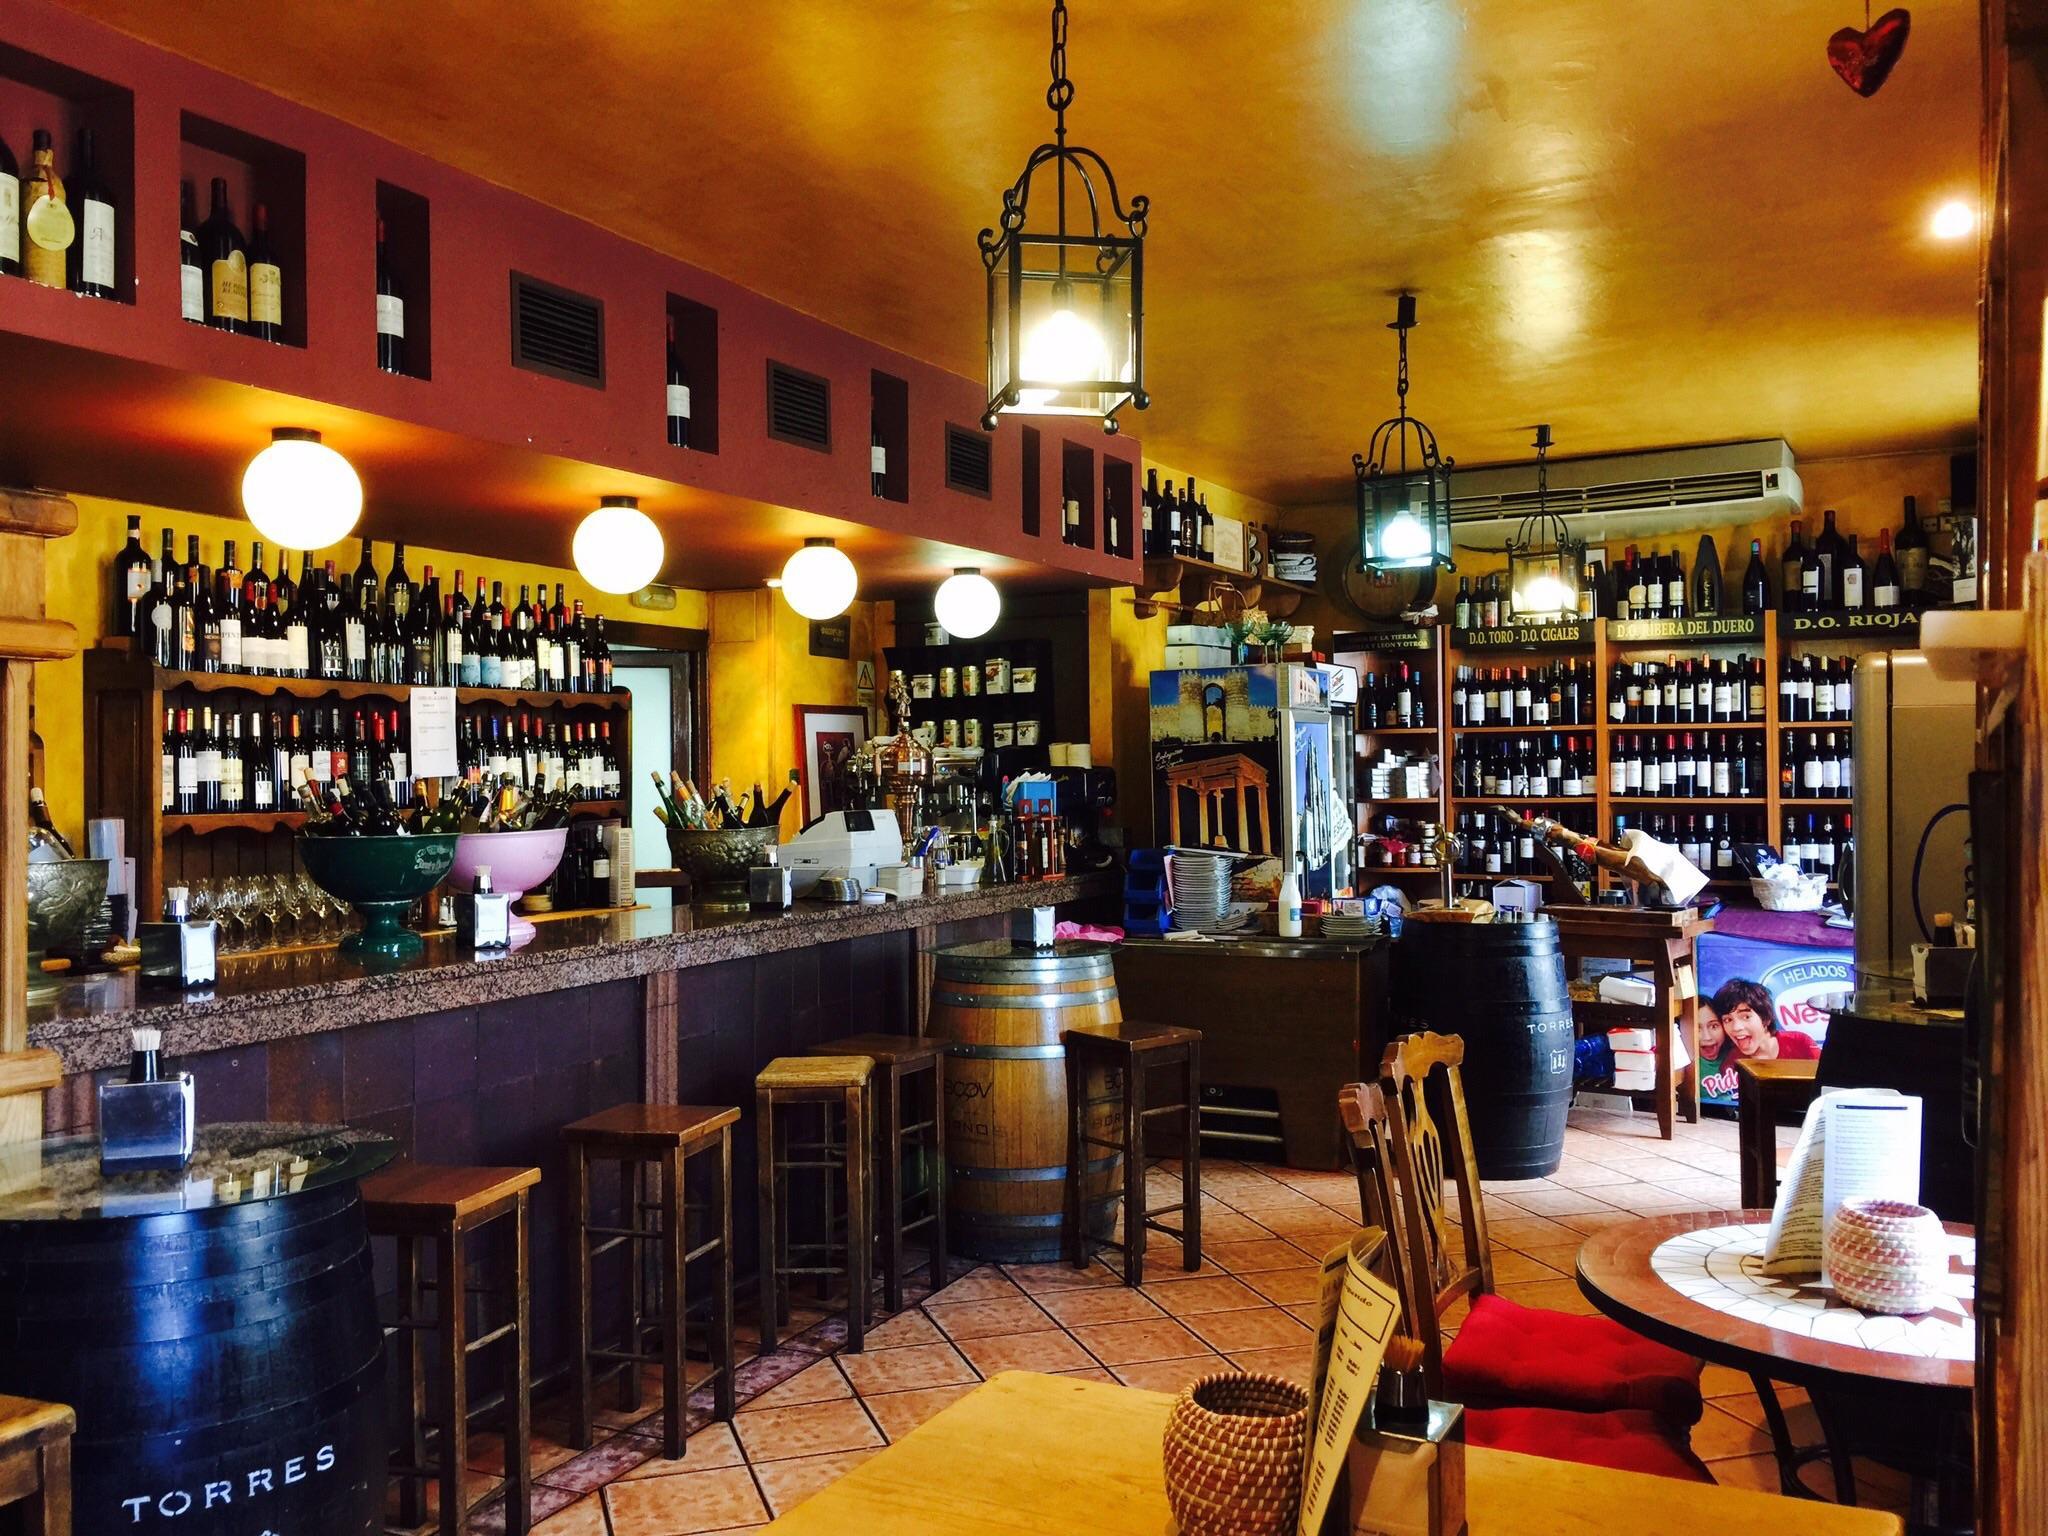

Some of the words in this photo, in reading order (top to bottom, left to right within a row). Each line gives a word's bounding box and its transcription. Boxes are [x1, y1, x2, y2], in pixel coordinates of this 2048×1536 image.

[1646, 622, 1684, 636] RIBERA
[1687, 621, 1710, 635] DEL
[1712, 618, 1754, 634] DUERO
[1793, 616, 1841, 630] D.O.
[1848, 612, 1919, 628] RIOJA
[1469, 631, 1487, 644] D.O.
[1489, 630, 1514, 643] TORO
[1520, 629, 1539, 642] D.O.
[1541, 627, 1580, 641] CIGALES
[1783, 965, 1847, 985] HELADOS
[121, 1444, 335, 1524] TORRES
